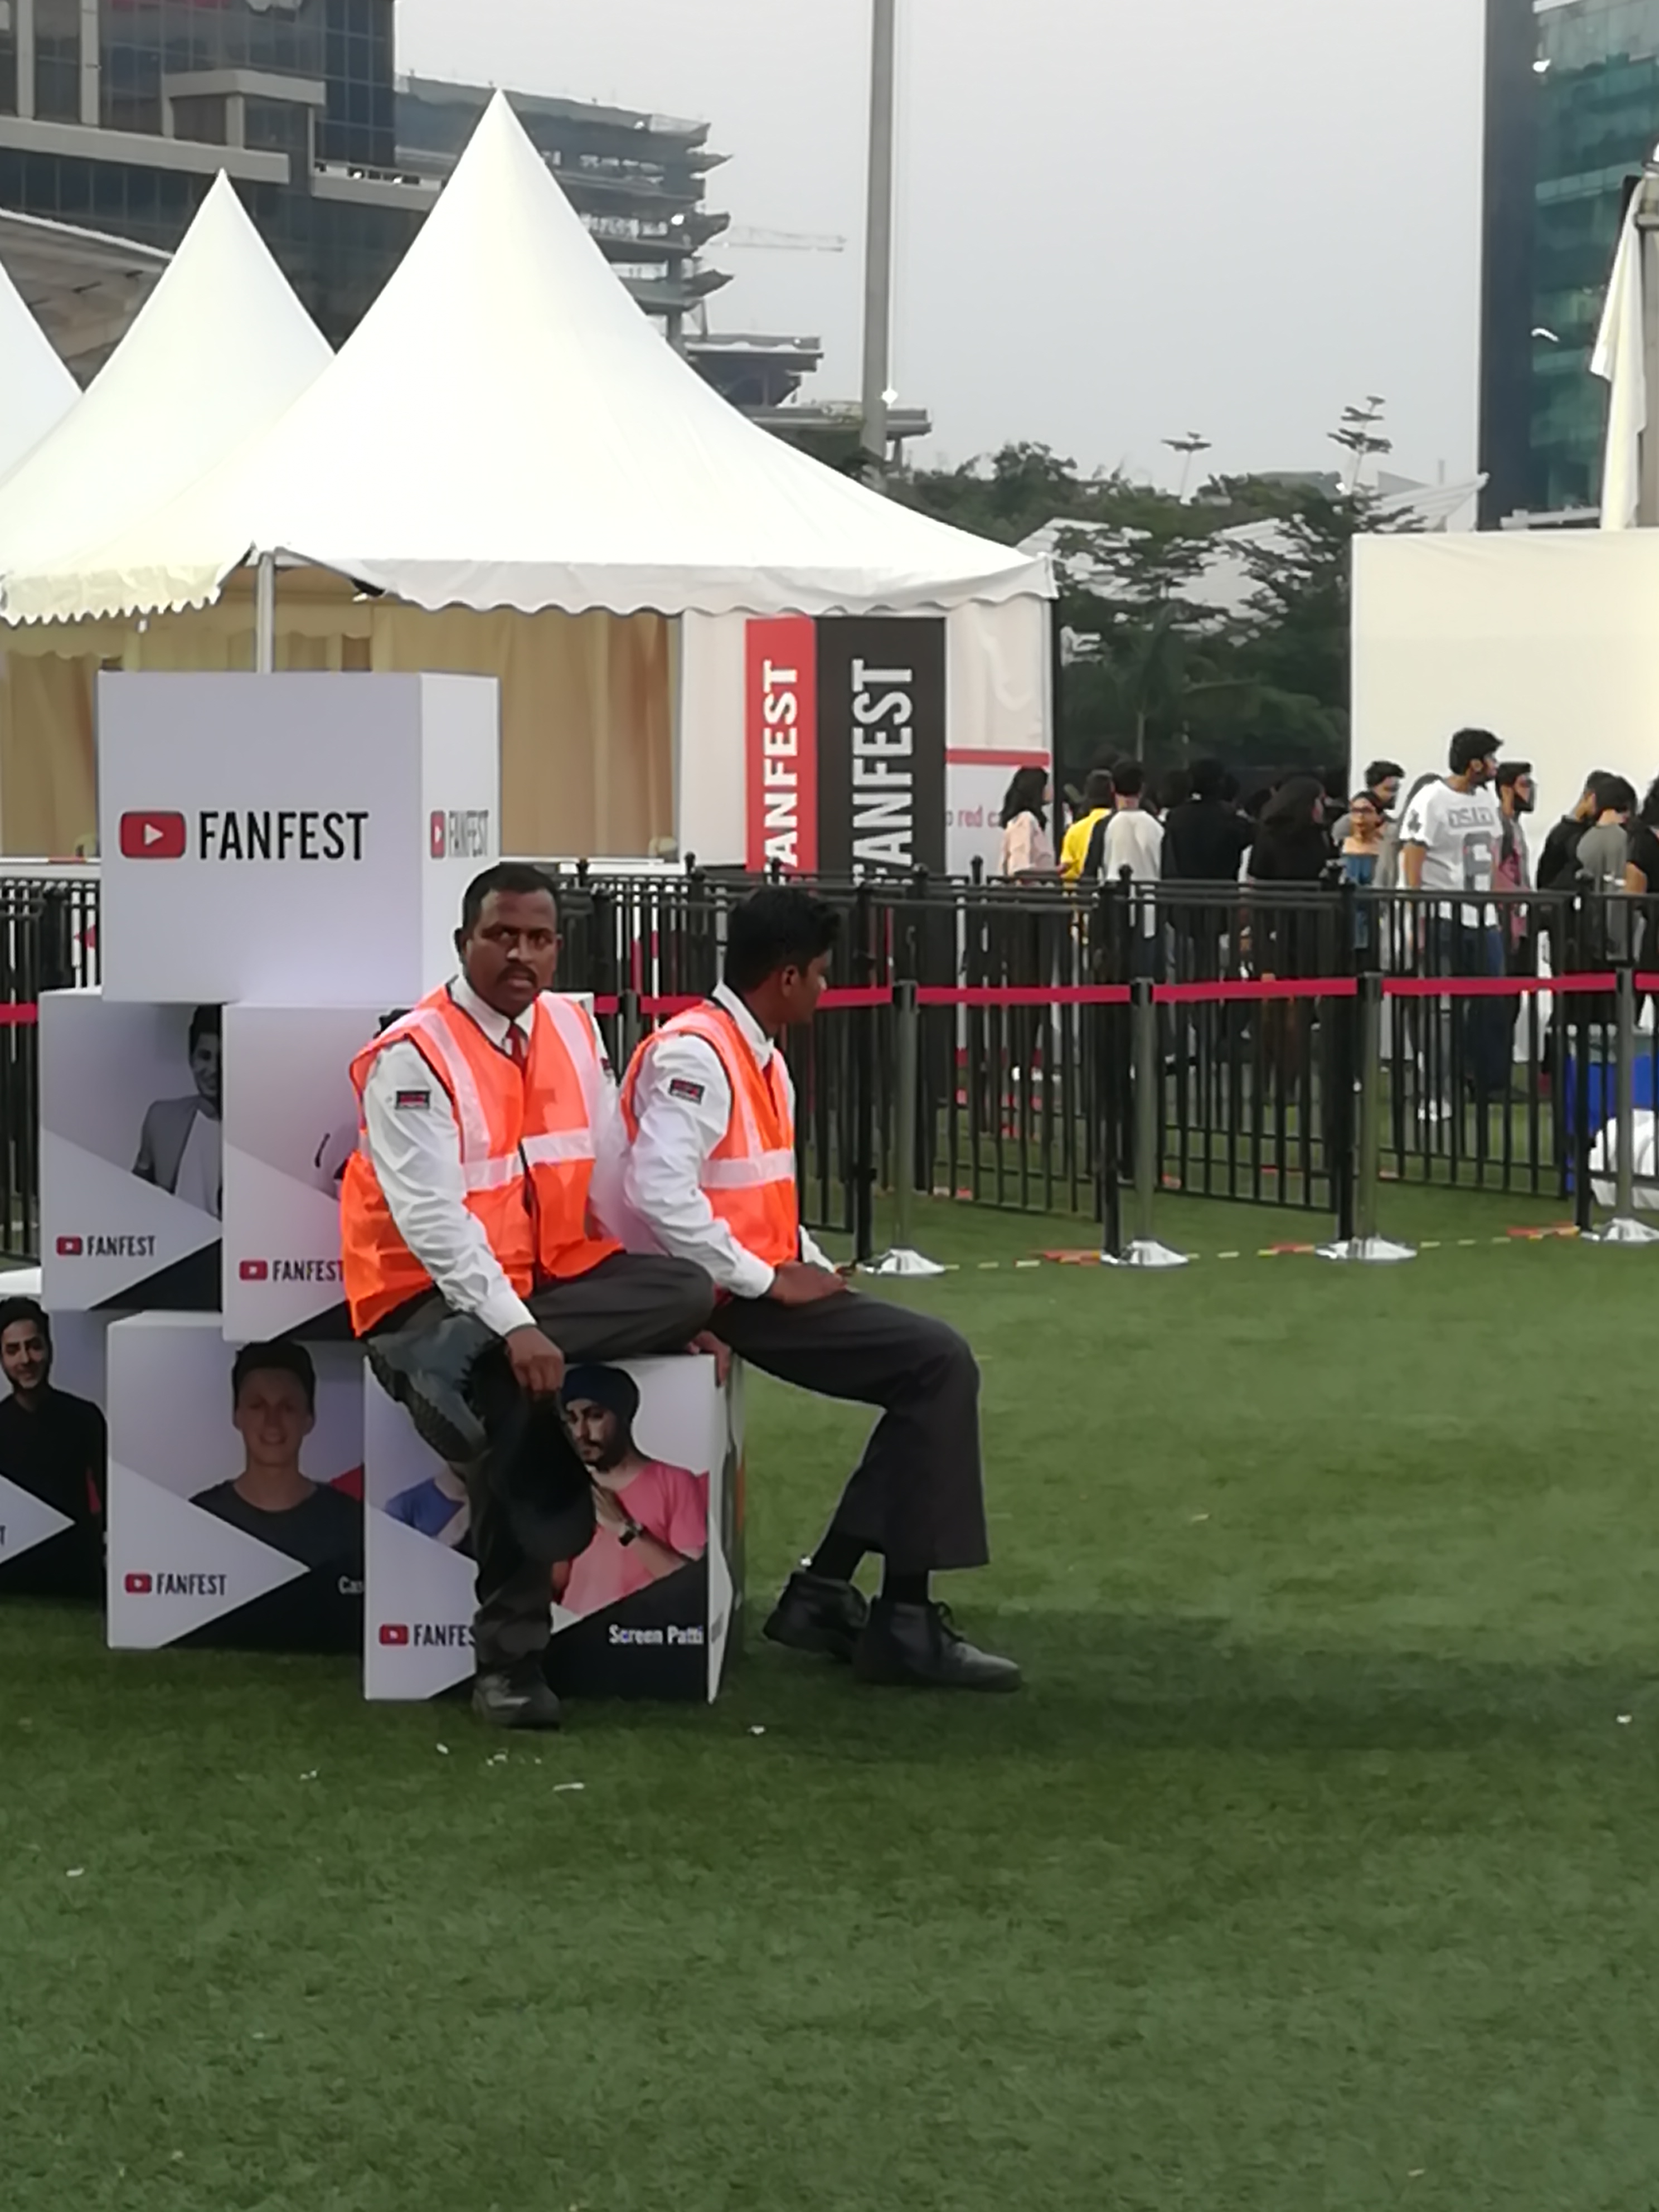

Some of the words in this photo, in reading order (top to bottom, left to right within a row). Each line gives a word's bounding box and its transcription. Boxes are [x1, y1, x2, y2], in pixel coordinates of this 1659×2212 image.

[199, 811, 368, 860] FANFEST
[87, 1235, 155, 1257] FANFEST
[273, 1260, 343, 1282] FANFEST
[157, 1573, 227, 1595] FANFEST
[414, 1624, 476, 1647] FANFE
[609, 1624, 663, 1645] Screen
